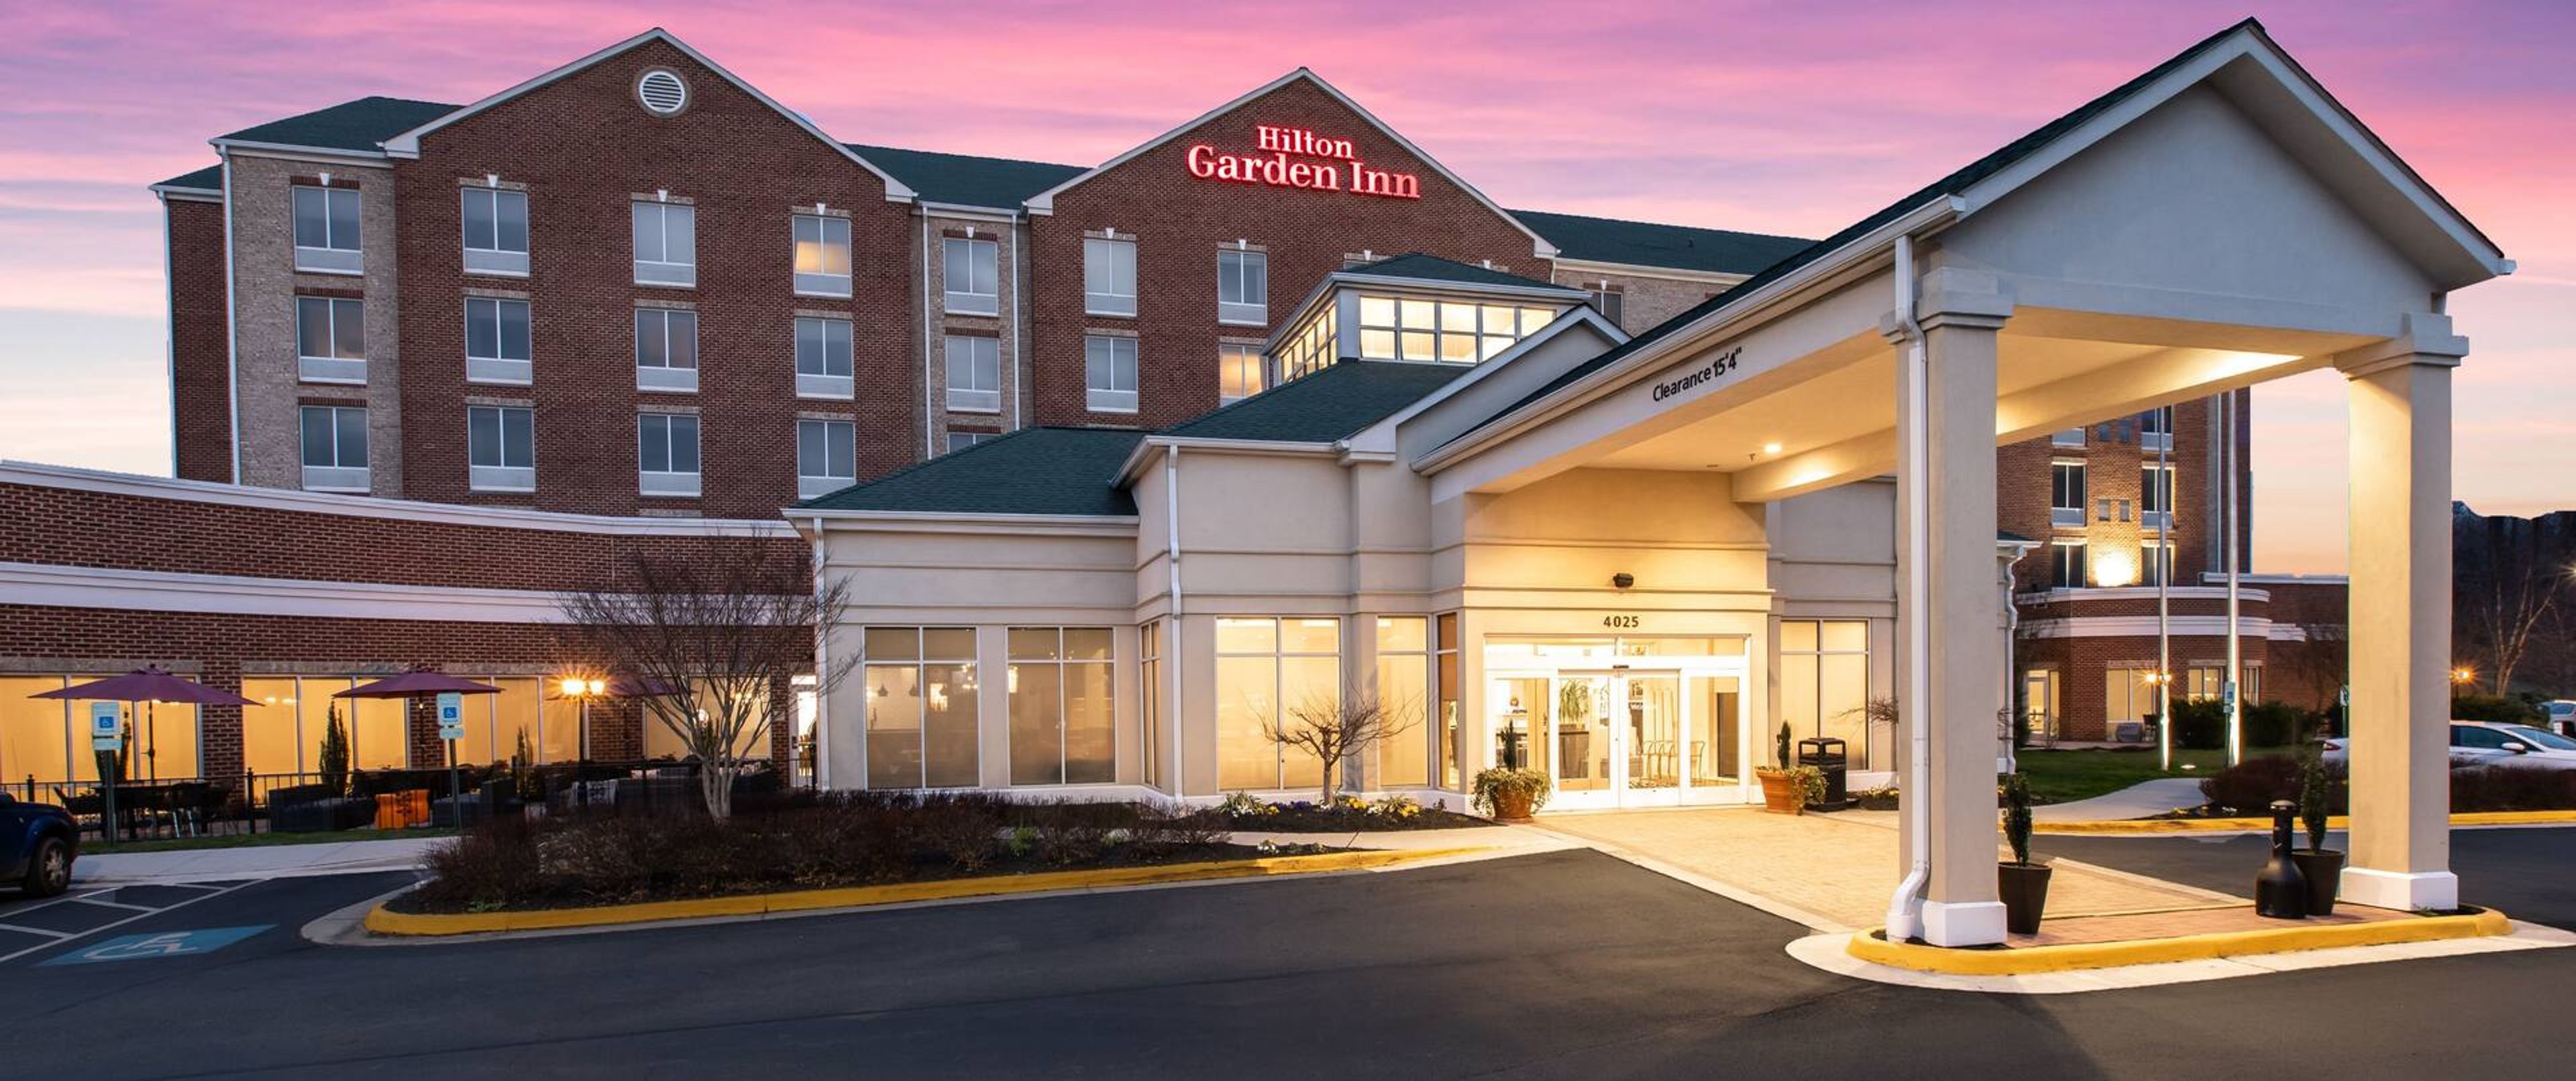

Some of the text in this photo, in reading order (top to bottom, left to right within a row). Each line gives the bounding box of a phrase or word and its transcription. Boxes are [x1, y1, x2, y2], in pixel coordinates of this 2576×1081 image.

[1256, 125, 1354, 160] Hilton
[1187, 144, 1420, 199] Garden Inn
[1653, 367, 1711, 402] Clearance
[1603, 616, 1639, 627] 4025
